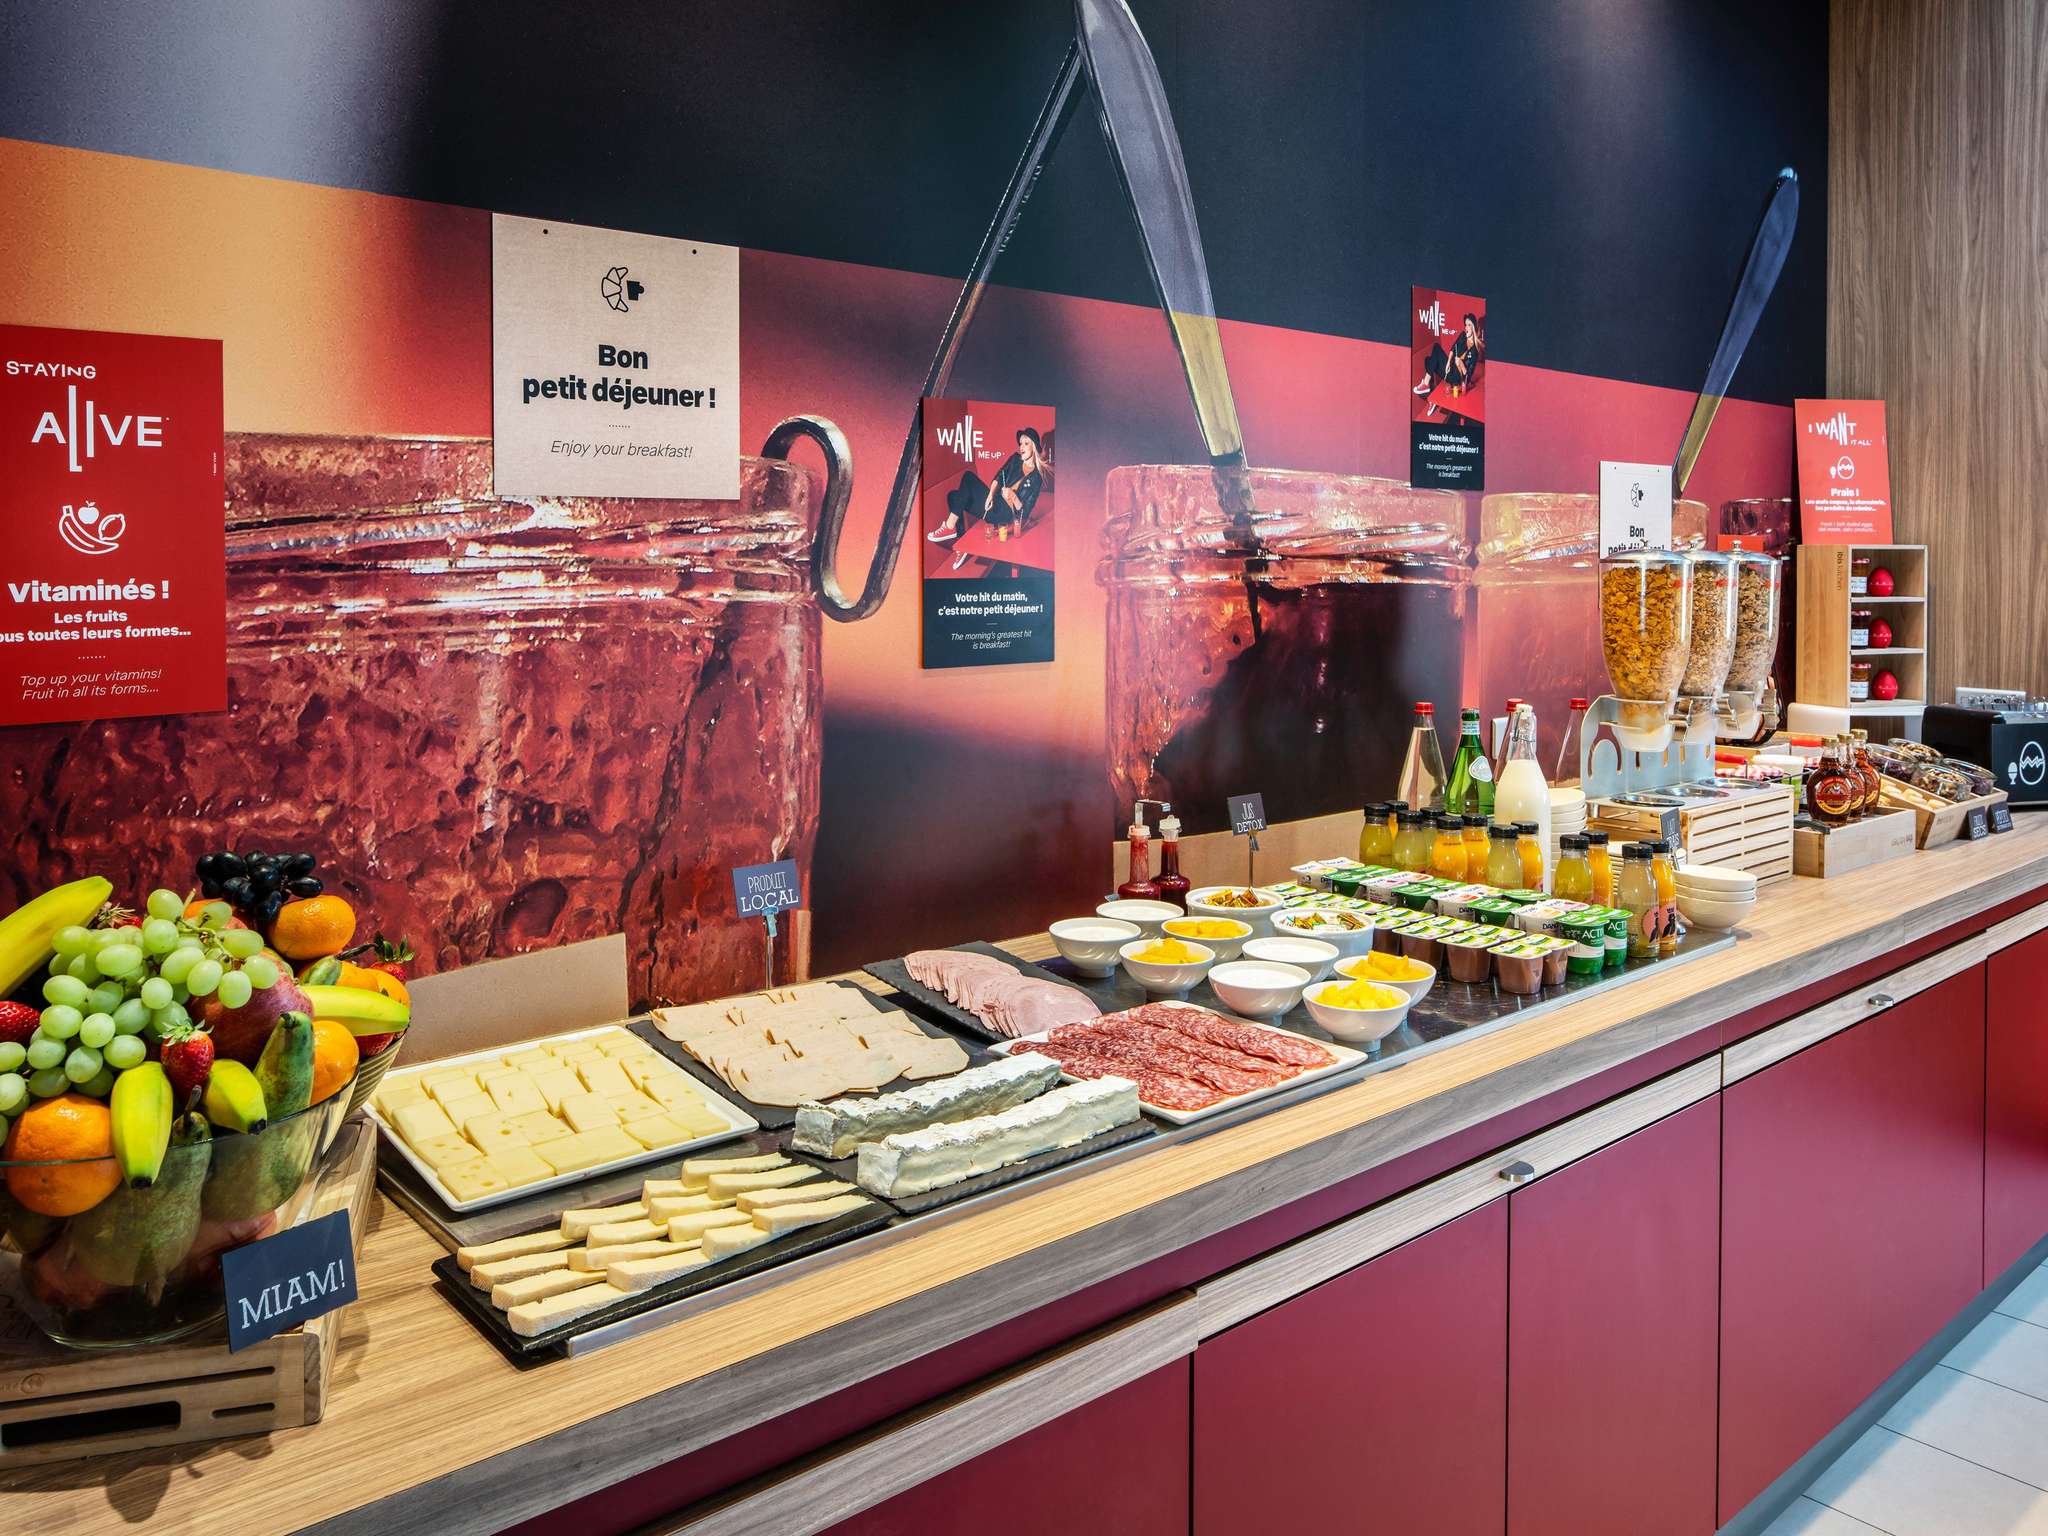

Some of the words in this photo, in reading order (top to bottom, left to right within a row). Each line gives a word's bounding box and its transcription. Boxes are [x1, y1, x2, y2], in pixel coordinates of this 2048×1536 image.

[1418, 300, 1445, 337] WAKE
[598, 344, 648, 369] Bon
[6, 361, 97, 379] STAYING
[523, 374, 587, 404] petit
[31, 385, 163, 473] ALIVE
[936, 415, 984, 462] WAKE
[1815, 412, 1857, 446] WANT
[550, 440, 591, 457] Enjoy
[593, 443, 625, 458] your
[627, 442, 693, 459] breakfast!
[978, 450, 990, 459] ME
[991, 450, 1002, 459] UP
[1629, 525, 1645, 537] Bon
[954, 593, 978, 602] Votre
[979, 592, 990, 602] hit
[991, 592, 1001, 601] du
[1002, 591, 1028, 602] matin,
[54, 612, 83, 624] Les
[86, 610, 128, 623] fruits
[960, 606, 983, 615] notre
[983, 604, 1003, 616] petit
[28, 629, 80, 642] toutes
[83, 627, 122, 640] leurs
[125, 625, 192, 638] formes...
[951, 633, 964, 641] The
[996, 631, 1023, 640] greatest
[1024, 630, 1032, 638] hit
[20, 675, 46, 688] Top
[50, 676, 67, 687] up
[71, 672, 101, 687] your
[104, 668, 162, 682] vitamins!
[22, 688, 55, 700] Fruit
[57, 687, 69, 698] in
[72, 685, 88, 697] all
[91, 685, 107, 696] its
[1236, 819, 1264, 833] DETOX
[747, 871, 787, 894] PRODUIT
[740, 888, 799, 912] LOCAL
[238, 1258, 346, 1329] MIAM!
